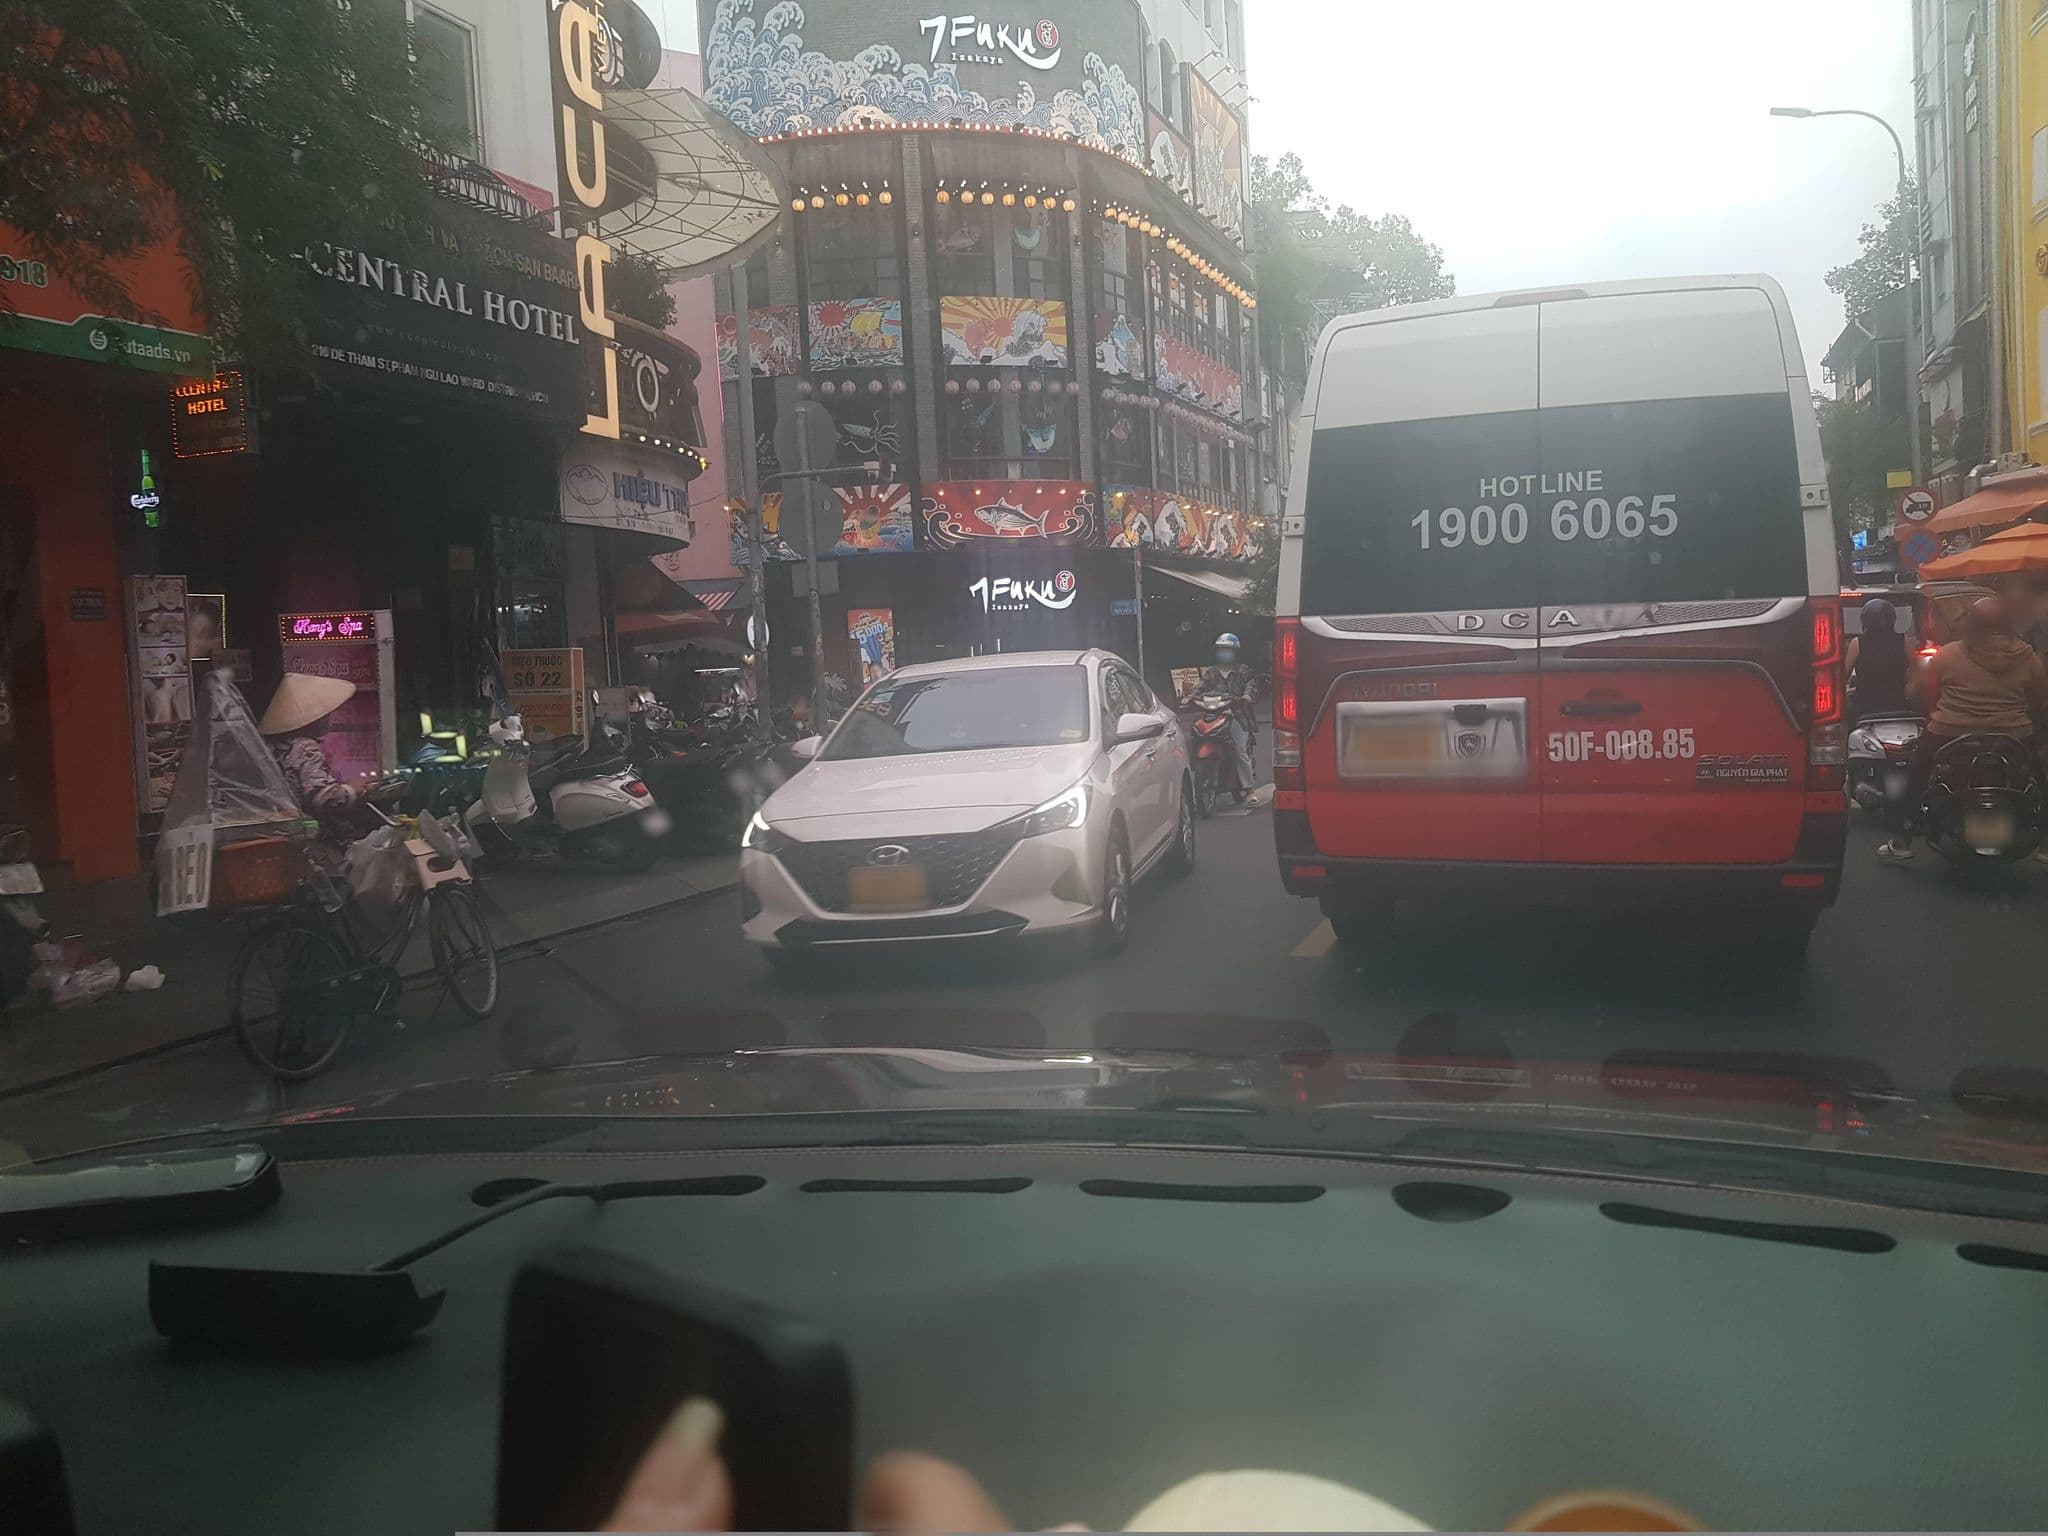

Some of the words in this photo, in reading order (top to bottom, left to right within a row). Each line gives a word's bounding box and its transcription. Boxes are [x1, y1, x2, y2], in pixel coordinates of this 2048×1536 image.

[482, 290, 580, 344] HOTEL
[347, 351, 376, 369] THAM
[440, 370, 459, 386] LAO
[187, 398, 228, 415] HOTEL
[1480, 470, 1603, 499] HOTLINE
[1410, 502, 1529, 549] 1900
[1550, 494, 1679, 541] 6065
[338, 617, 363, 635] Spa
[541, 671, 561, 687] 22
